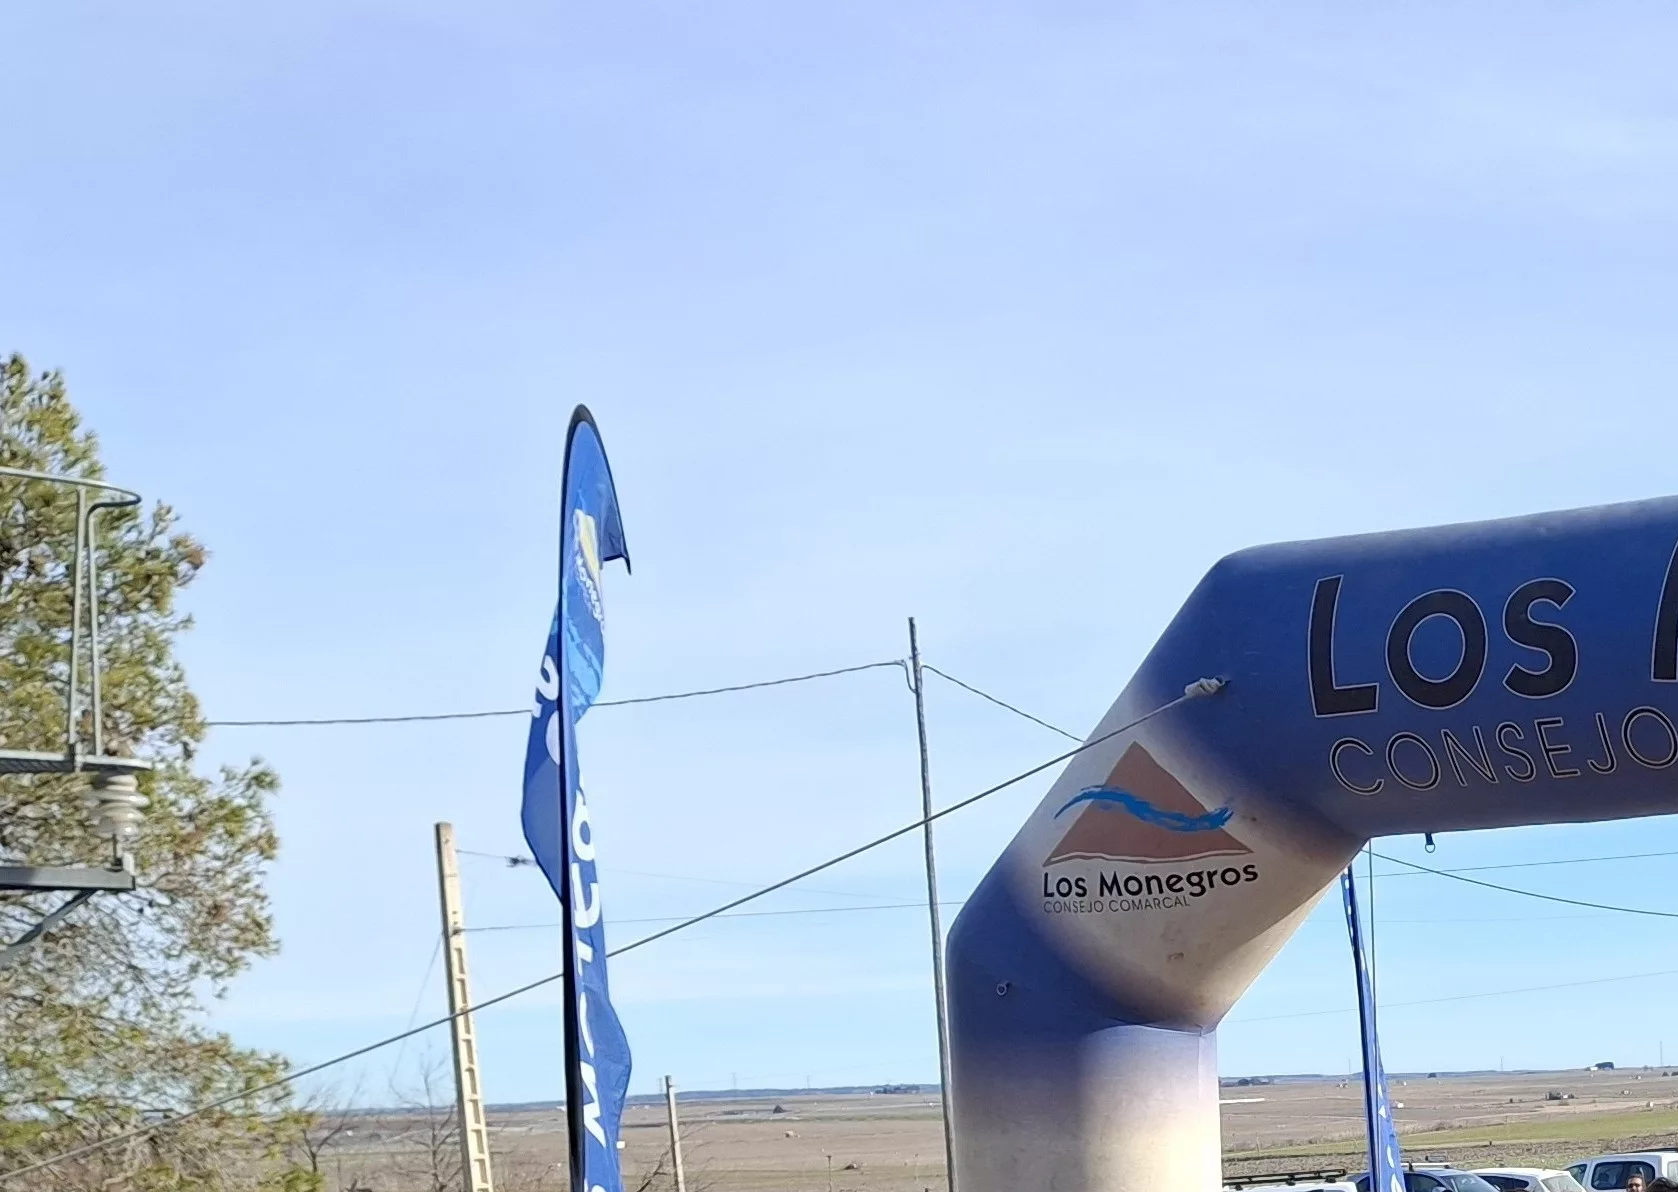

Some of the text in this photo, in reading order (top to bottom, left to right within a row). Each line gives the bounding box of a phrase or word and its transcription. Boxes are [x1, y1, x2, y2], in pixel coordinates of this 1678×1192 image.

[1043, 864, 1259, 898] Los Monegros
[1043, 895, 1191, 914] CONSEJO COMARCAL
